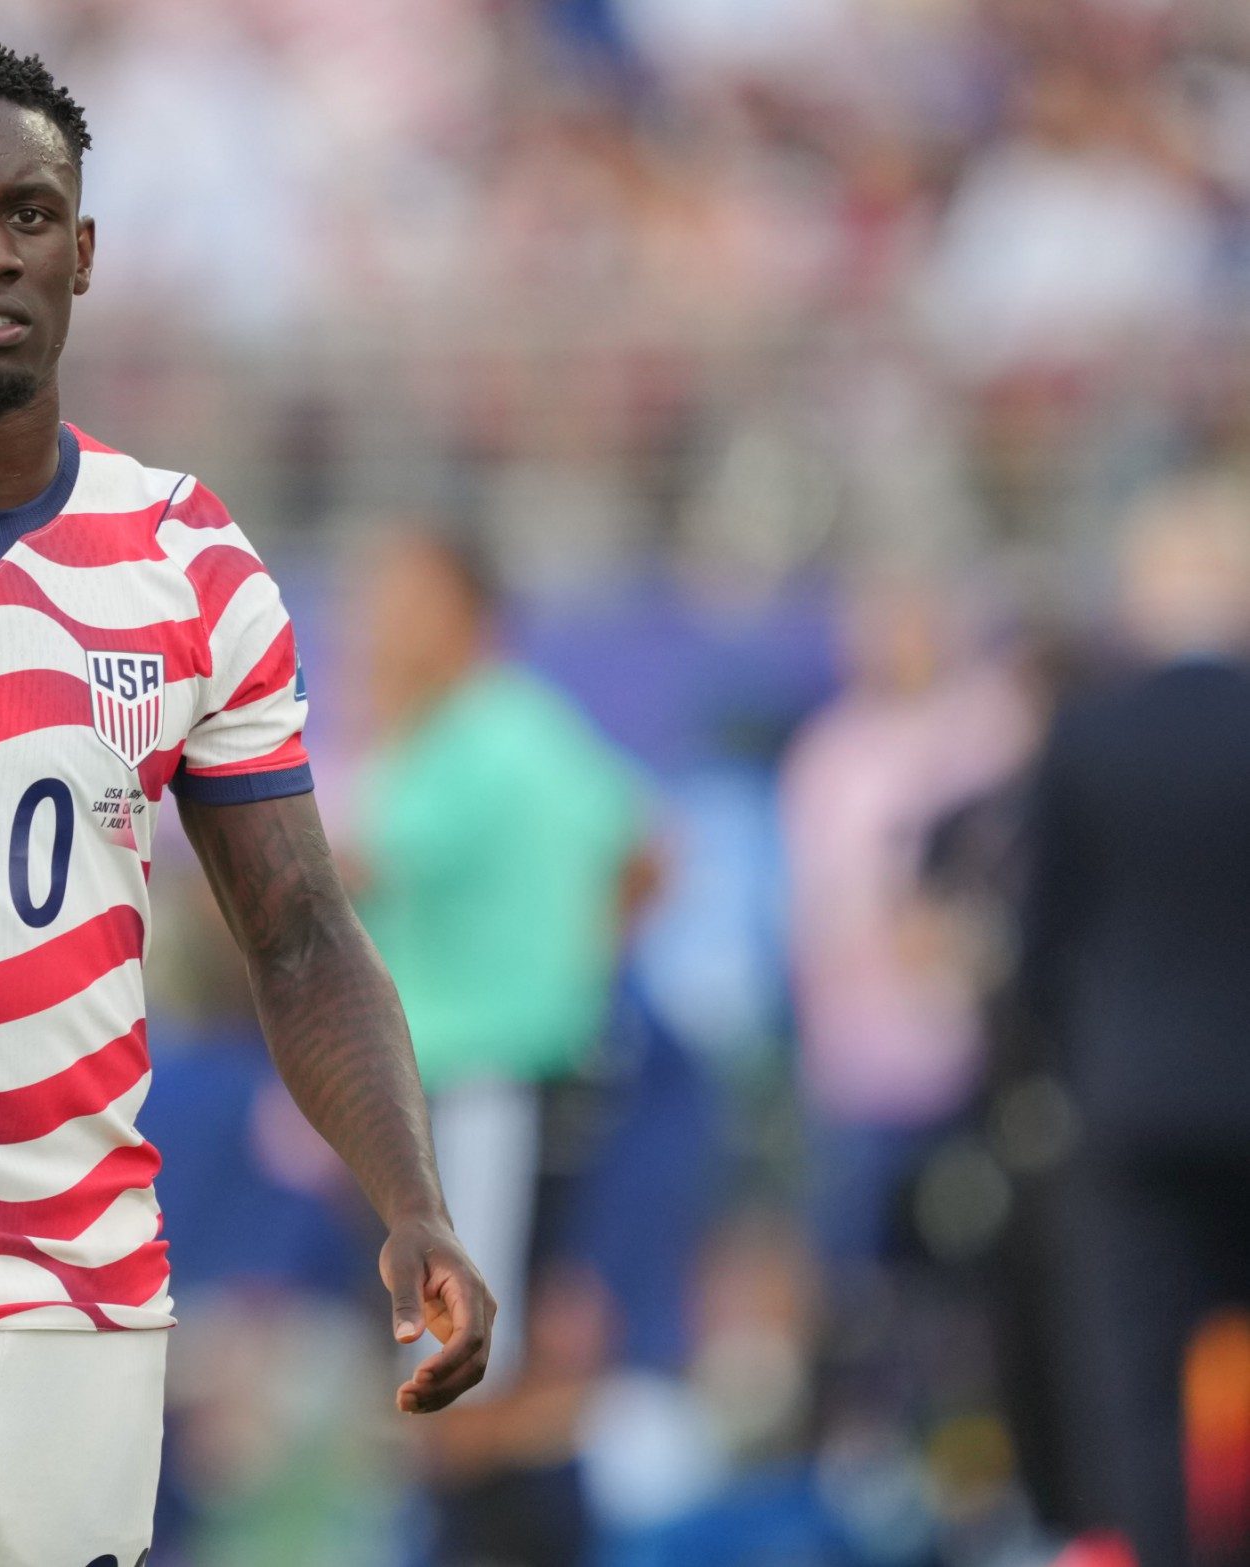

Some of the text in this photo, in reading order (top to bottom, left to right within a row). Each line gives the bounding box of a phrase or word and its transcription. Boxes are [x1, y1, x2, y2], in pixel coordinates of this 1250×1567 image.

[93, 657, 159, 701] USA
[104, 788, 123, 799] USA
[91, 801, 121, 814] SANTA
[106, 817, 127, 829] JULY
